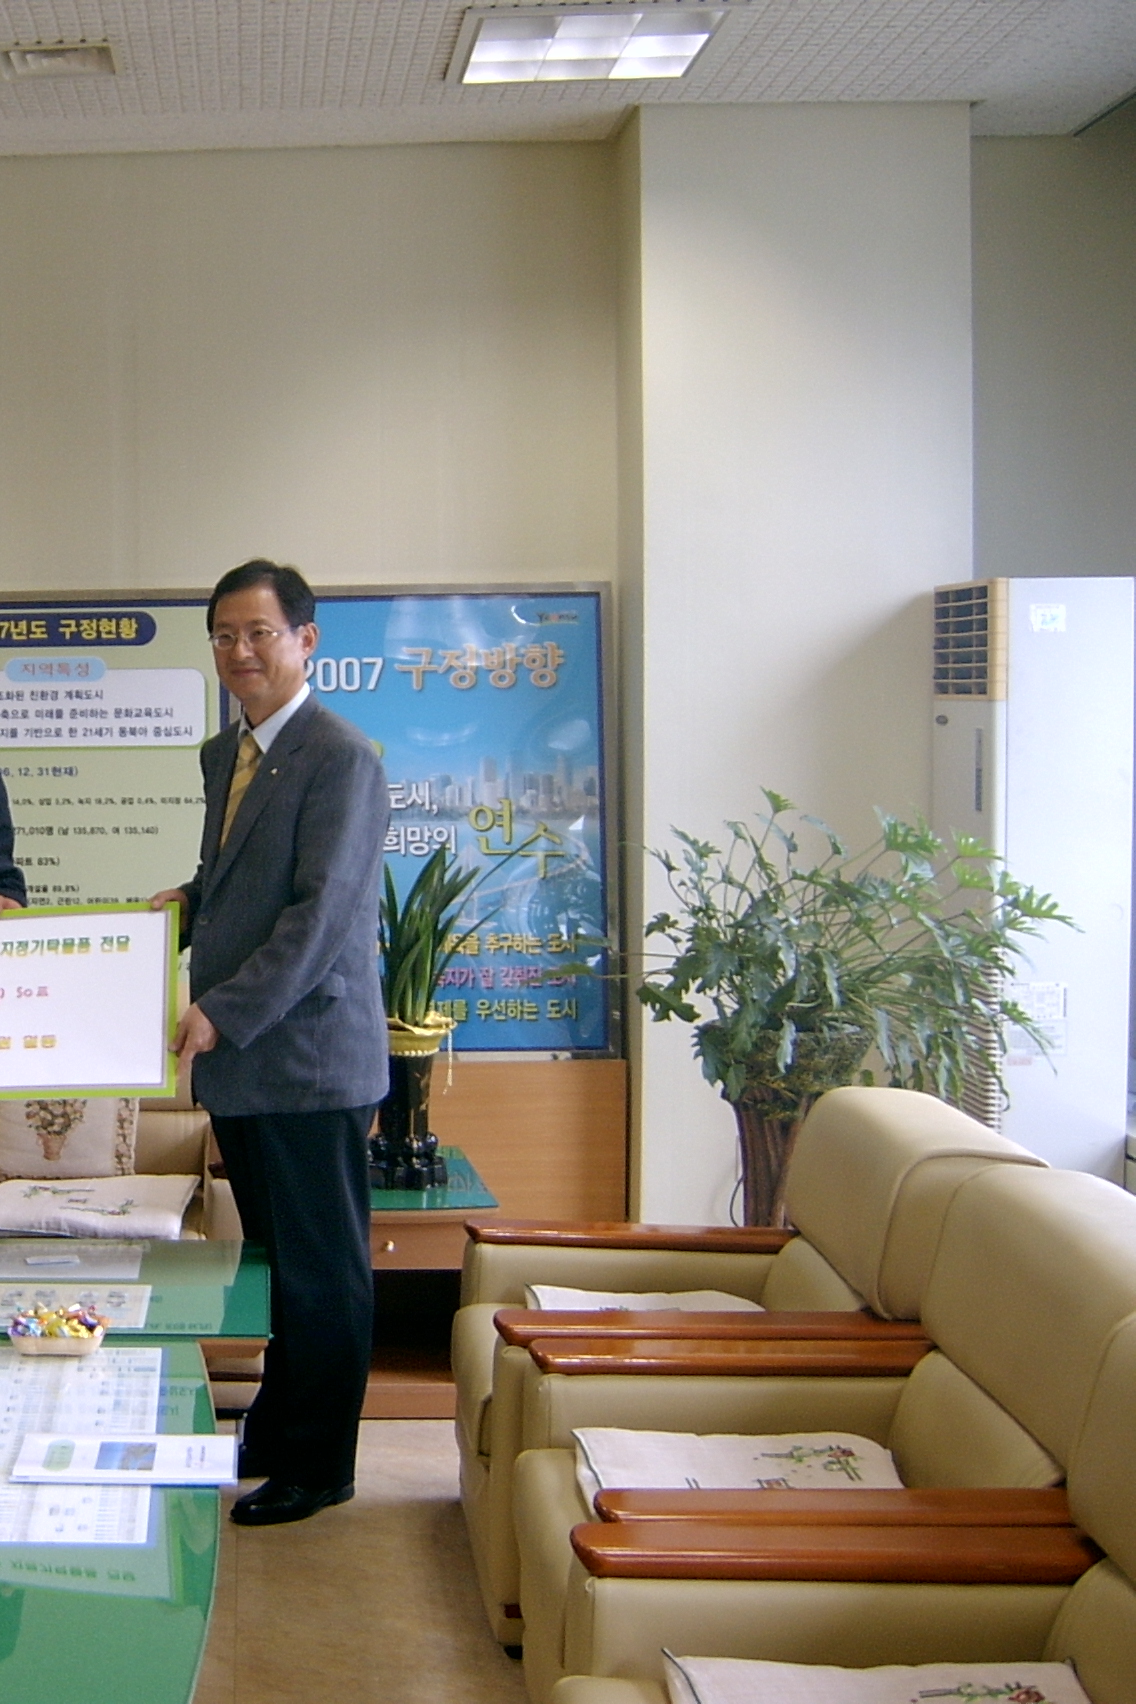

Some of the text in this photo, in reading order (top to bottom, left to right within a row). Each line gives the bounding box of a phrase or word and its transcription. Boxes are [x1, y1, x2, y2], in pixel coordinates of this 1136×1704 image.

[59, 618, 139, 639] 구정현황
[20, 660, 91, 678] 지역특성
[395, 641, 564, 691] 구정방향
[29, 689, 59, 701] 친환경
[64, 689, 104, 701] 계획도시
[34, 708, 64, 720] 미래를
[69, 707, 108, 719] 준비하는
[113, 707, 174, 719] 문화교육도시
[24, 726, 63, 739] 기반으로
[68, 726, 79, 738] 한
[82, 726, 113, 738] 21세기
[118, 726, 149, 738] 동북아
[153, 725, 193, 738] 중심도시
[383, 798, 566, 879] 희망의 연수
[0, 937, 91, 957] 지정기탁물품
[100, 935, 131, 952] 전달
[485, 932, 542, 955] 추구하는
[546, 931, 576, 953] 도시
[479, 966, 494, 989] 잘
[476, 999, 539, 1021] 우선하는
[546, 998, 577, 1020] 도시
[23, 1034, 57, 1048] 일동
